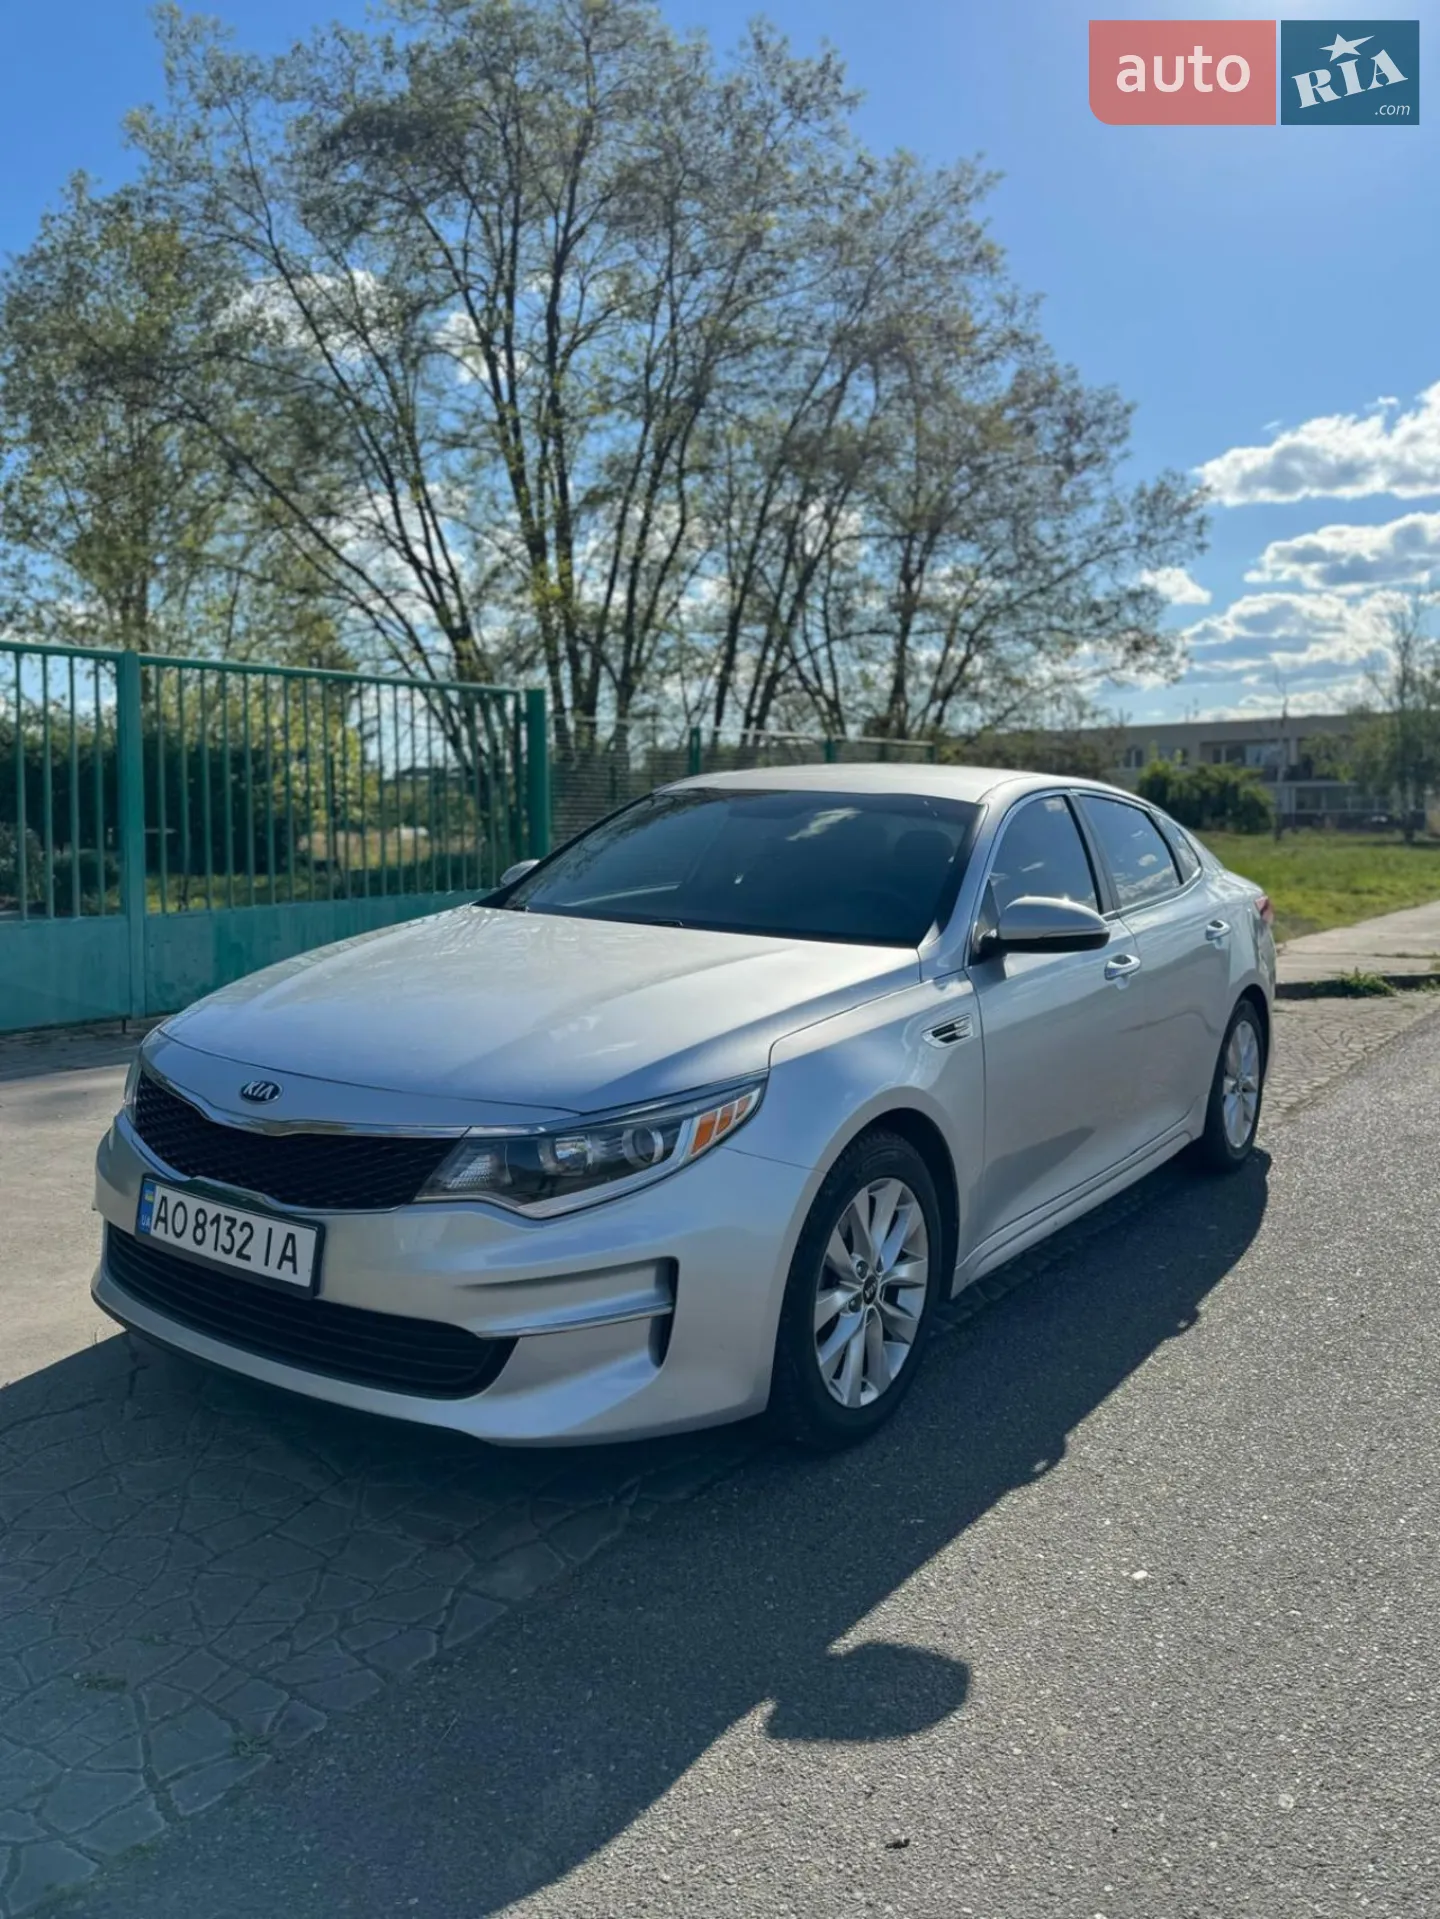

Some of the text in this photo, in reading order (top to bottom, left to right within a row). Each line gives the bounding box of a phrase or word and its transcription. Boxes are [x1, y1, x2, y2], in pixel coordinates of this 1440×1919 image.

[243, 1081, 274, 1099] KIA
[153, 1195, 298, 1275] AO 8132 IA
